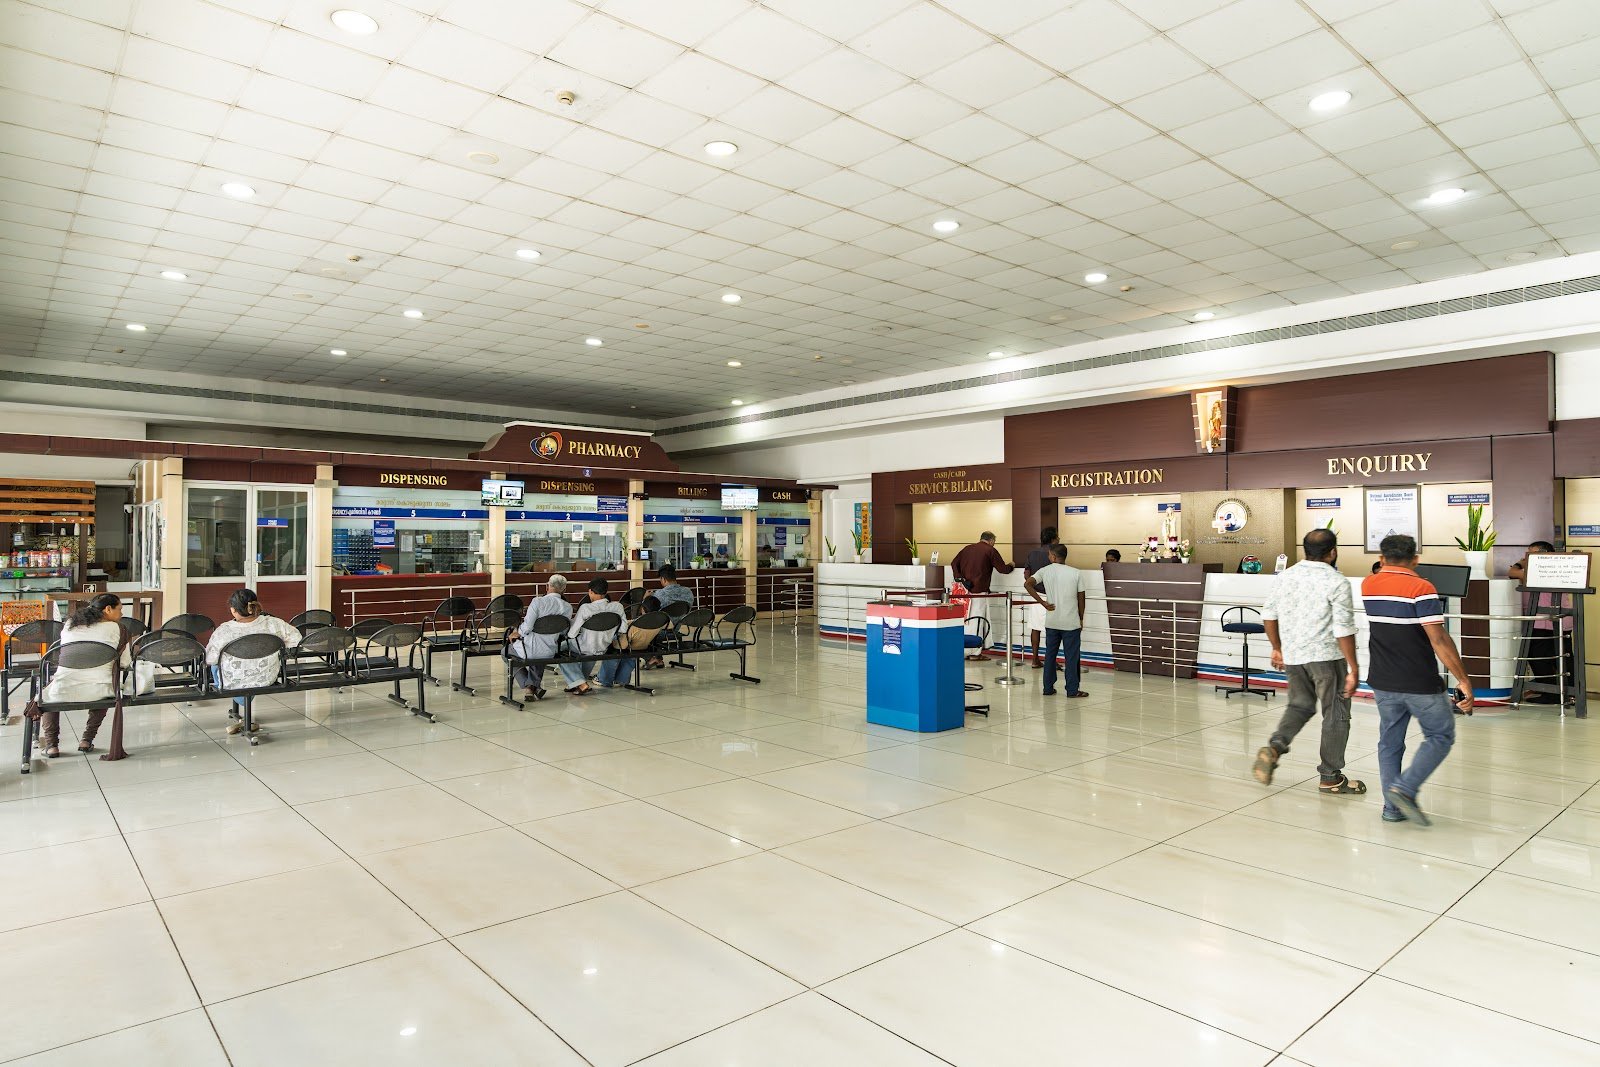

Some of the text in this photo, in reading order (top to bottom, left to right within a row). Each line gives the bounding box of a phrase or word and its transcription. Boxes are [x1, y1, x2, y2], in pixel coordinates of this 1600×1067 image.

[568, 440, 642, 459] PHARMACY
[1326, 452, 1432, 477] ENQUIRY
[380, 473, 448, 486] DISPENSING
[933, 470, 967, 479] CASH/CARD
[1050, 468, 1164, 488] REGISTRATION
[540, 480, 595, 492] DISPENSING
[678, 487, 708, 496] BILLING
[909, 479, 993, 495] SERVICE BILLING
[772, 491, 791, 500] CASH
[410, 509, 467, 518] 5 4
